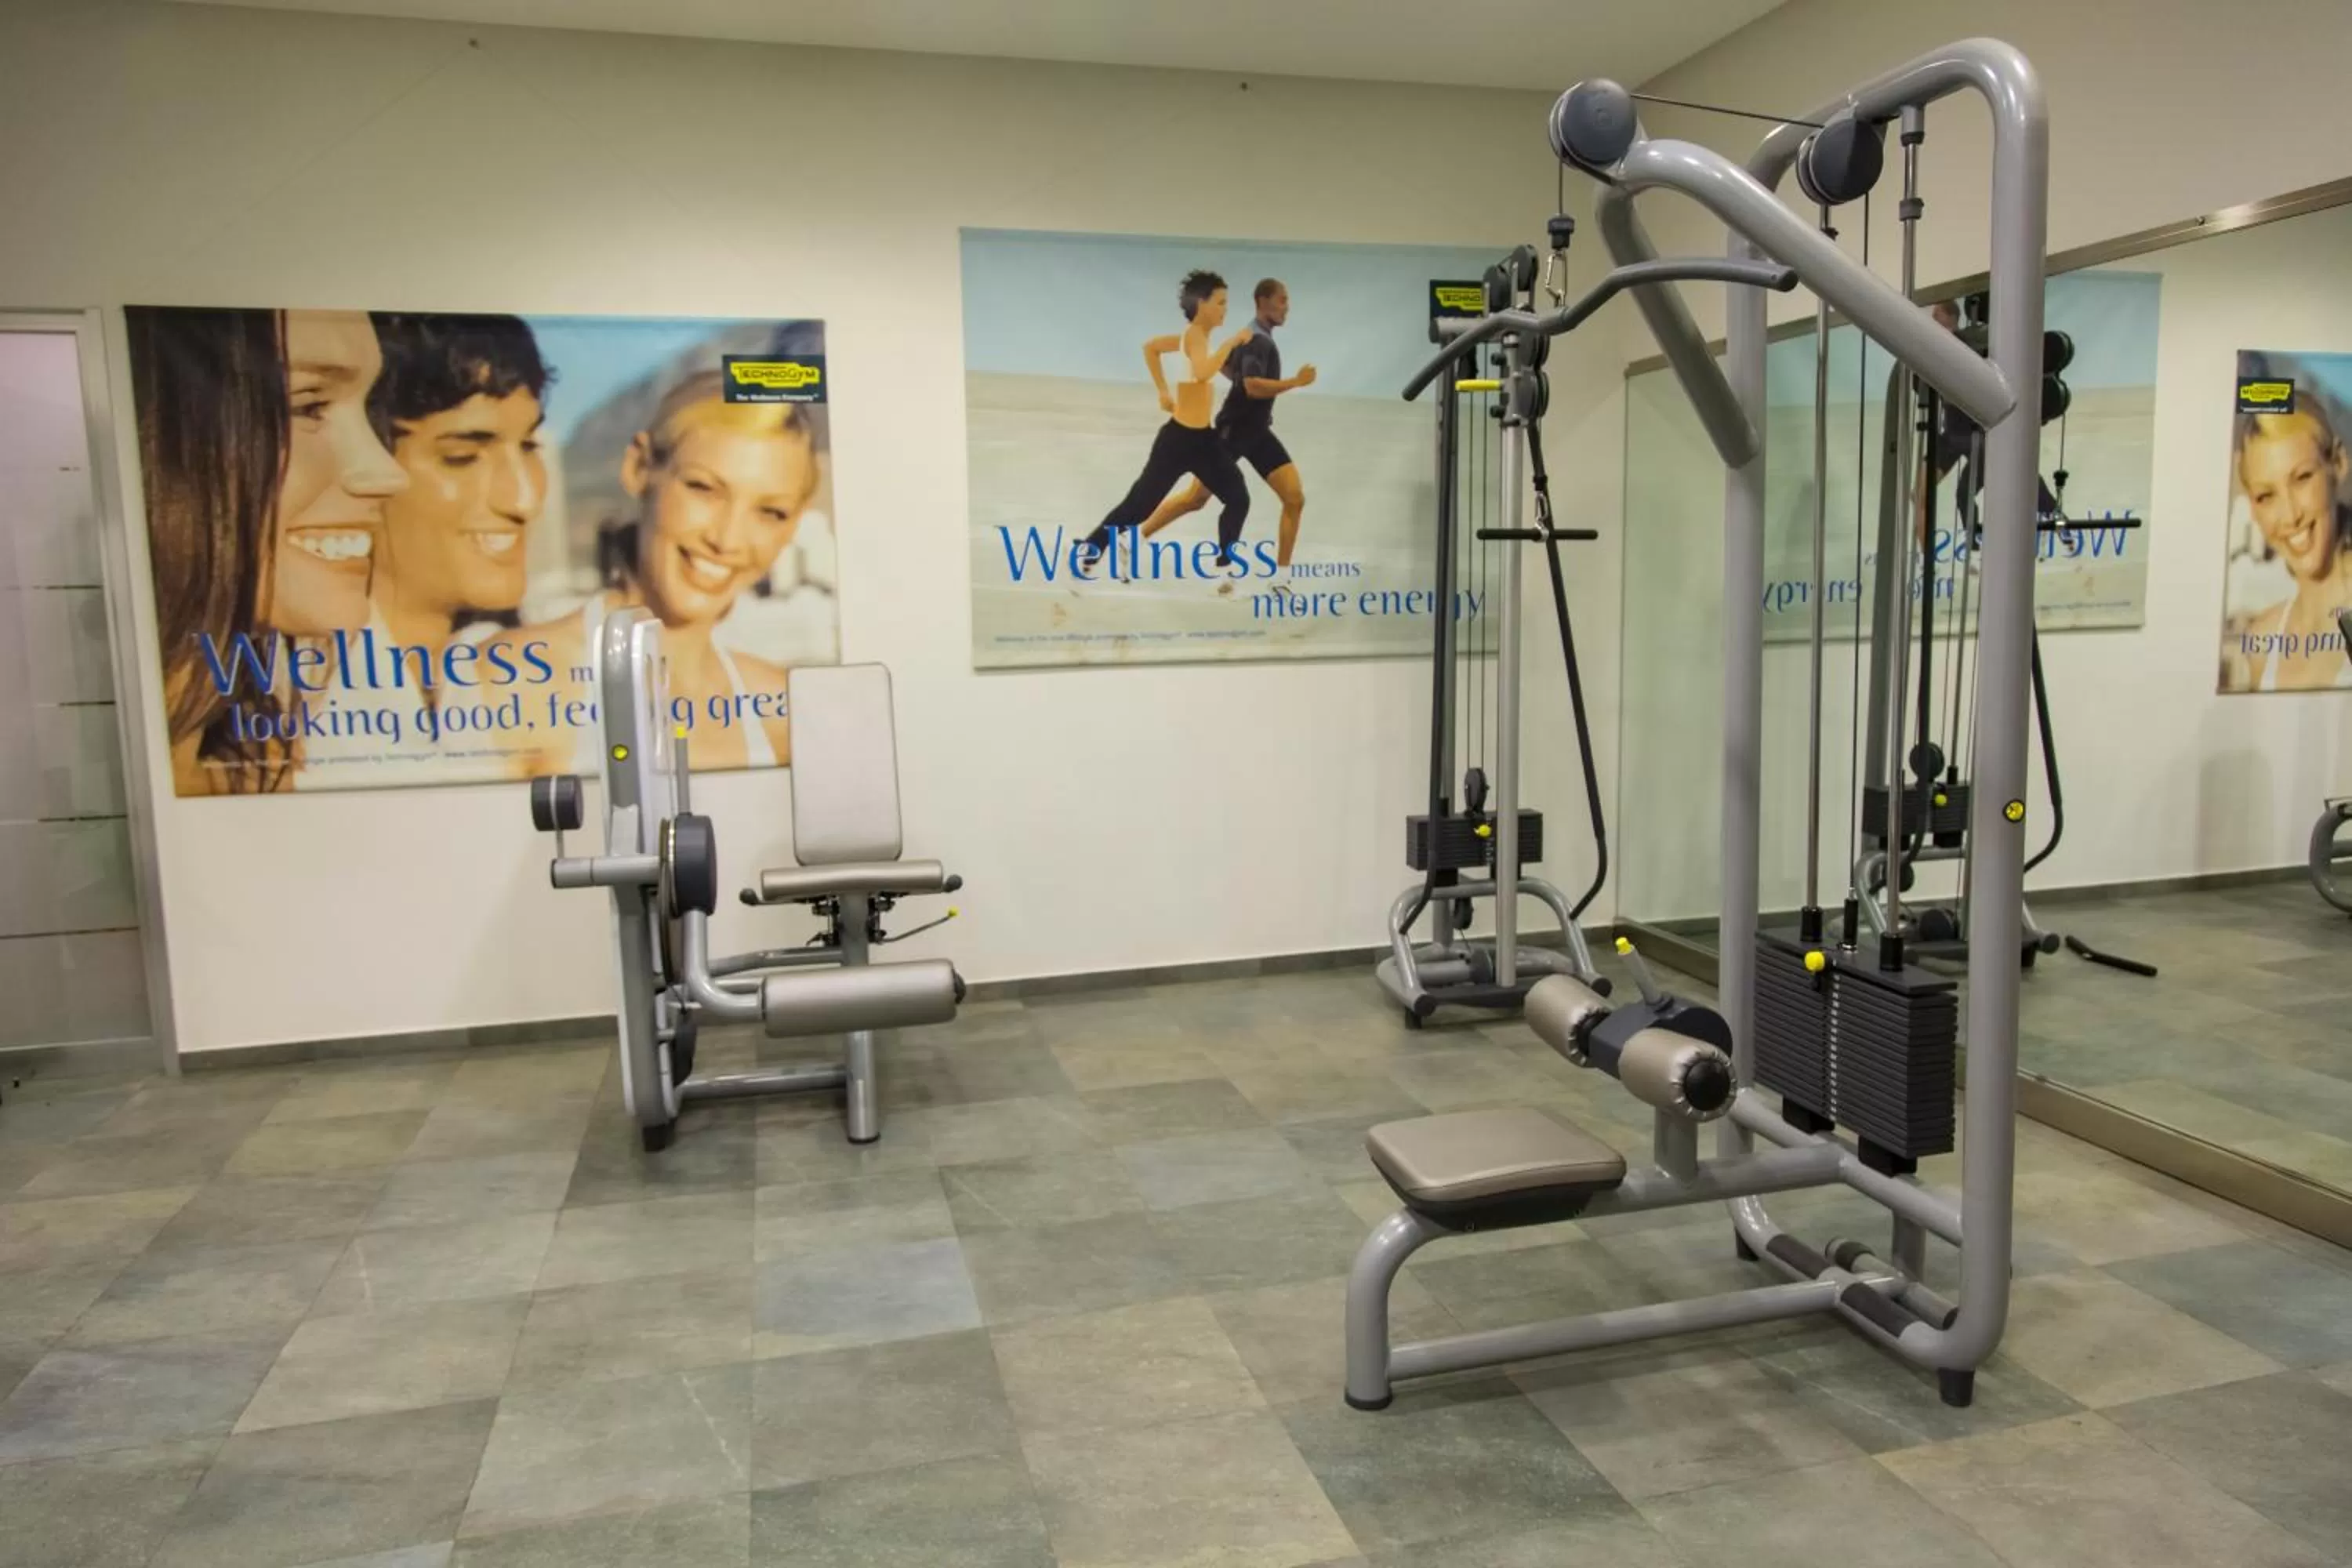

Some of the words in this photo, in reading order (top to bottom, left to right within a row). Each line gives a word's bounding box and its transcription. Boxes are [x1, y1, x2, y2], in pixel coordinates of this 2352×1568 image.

[993, 524, 1278, 581] Wellness
[1290, 561, 1361, 578] means
[1252, 590, 1347, 619] more
[1359, 588, 1485, 622] enery
[193, 628, 553, 696] Wellness
[230, 700, 401, 742] looking
[708, 691, 788, 728] grea
